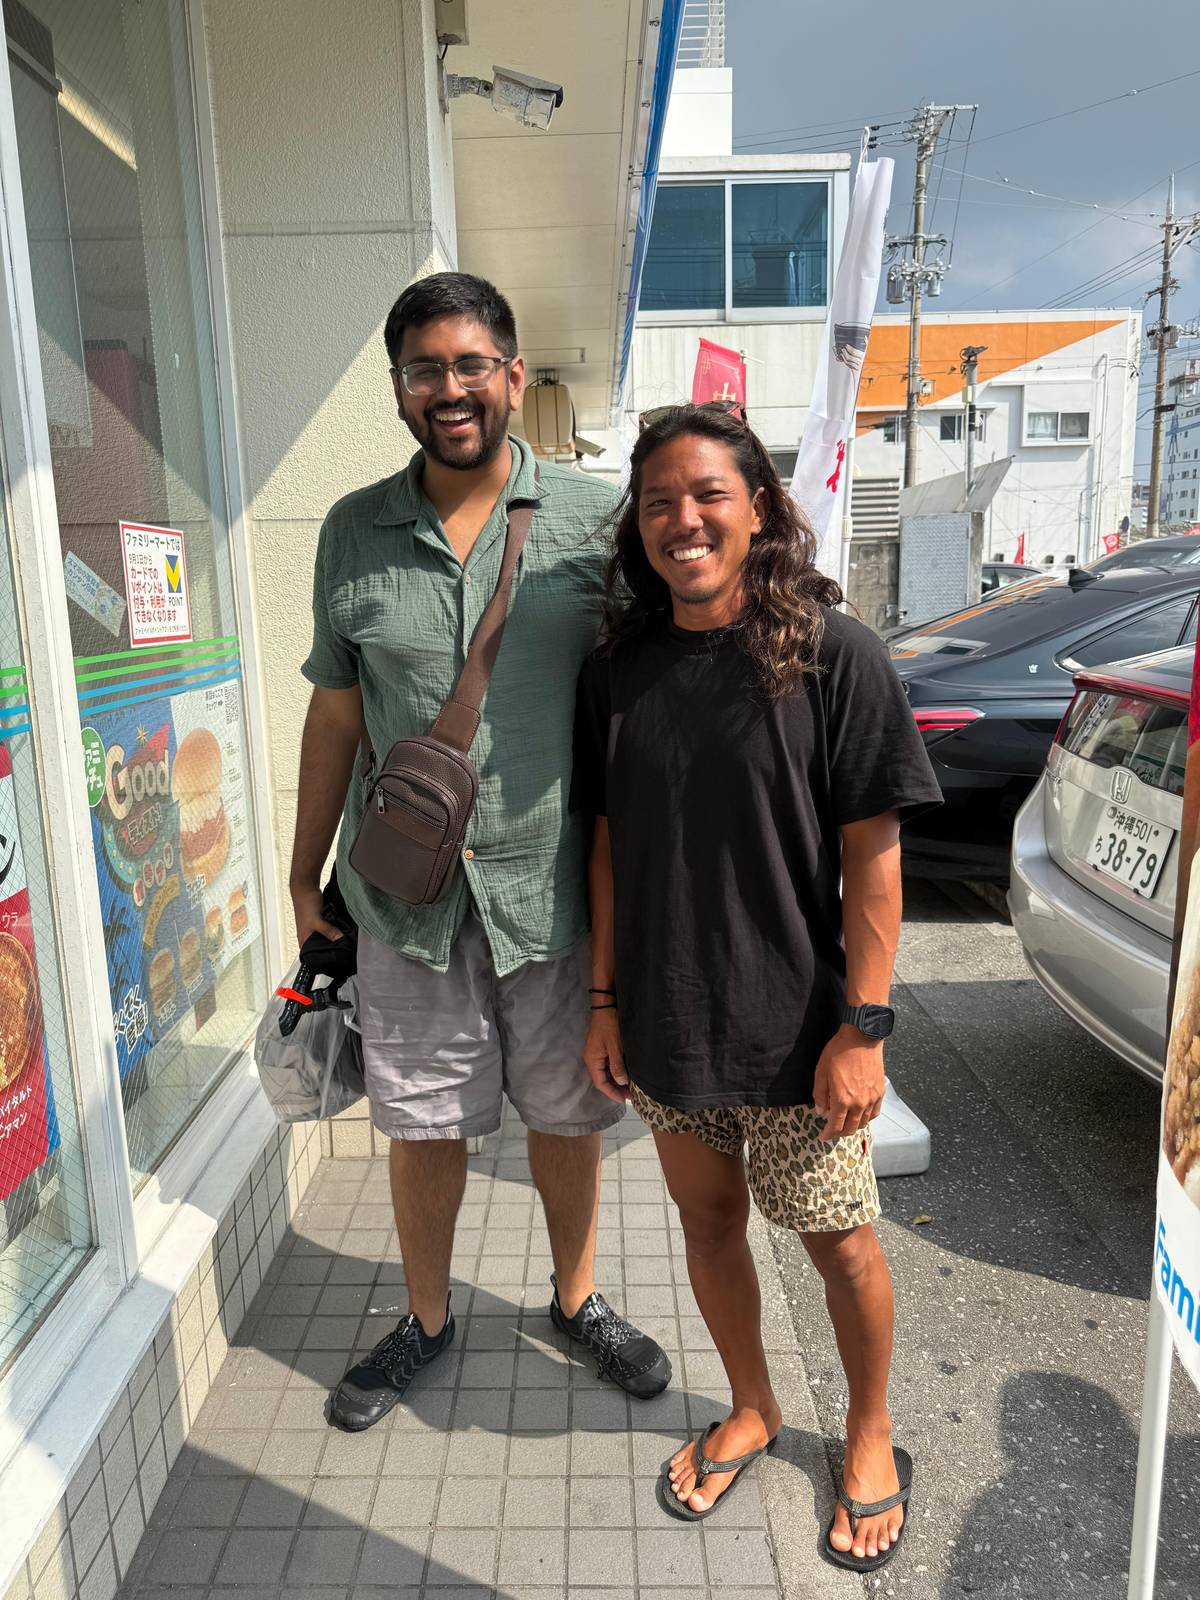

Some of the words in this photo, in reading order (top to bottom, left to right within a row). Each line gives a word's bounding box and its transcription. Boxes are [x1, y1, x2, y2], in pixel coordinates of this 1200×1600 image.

[125, 532, 181, 552] ファミリーマートでは
[130, 566, 159, 580] カードでの
[168, 596, 184, 607] POINT
[134, 608, 178, 623] できなくなります
[83, 741, 101, 768] ァミ
[106, 744, 170, 821] Good
[1100, 832, 1158, 889] 38-79
